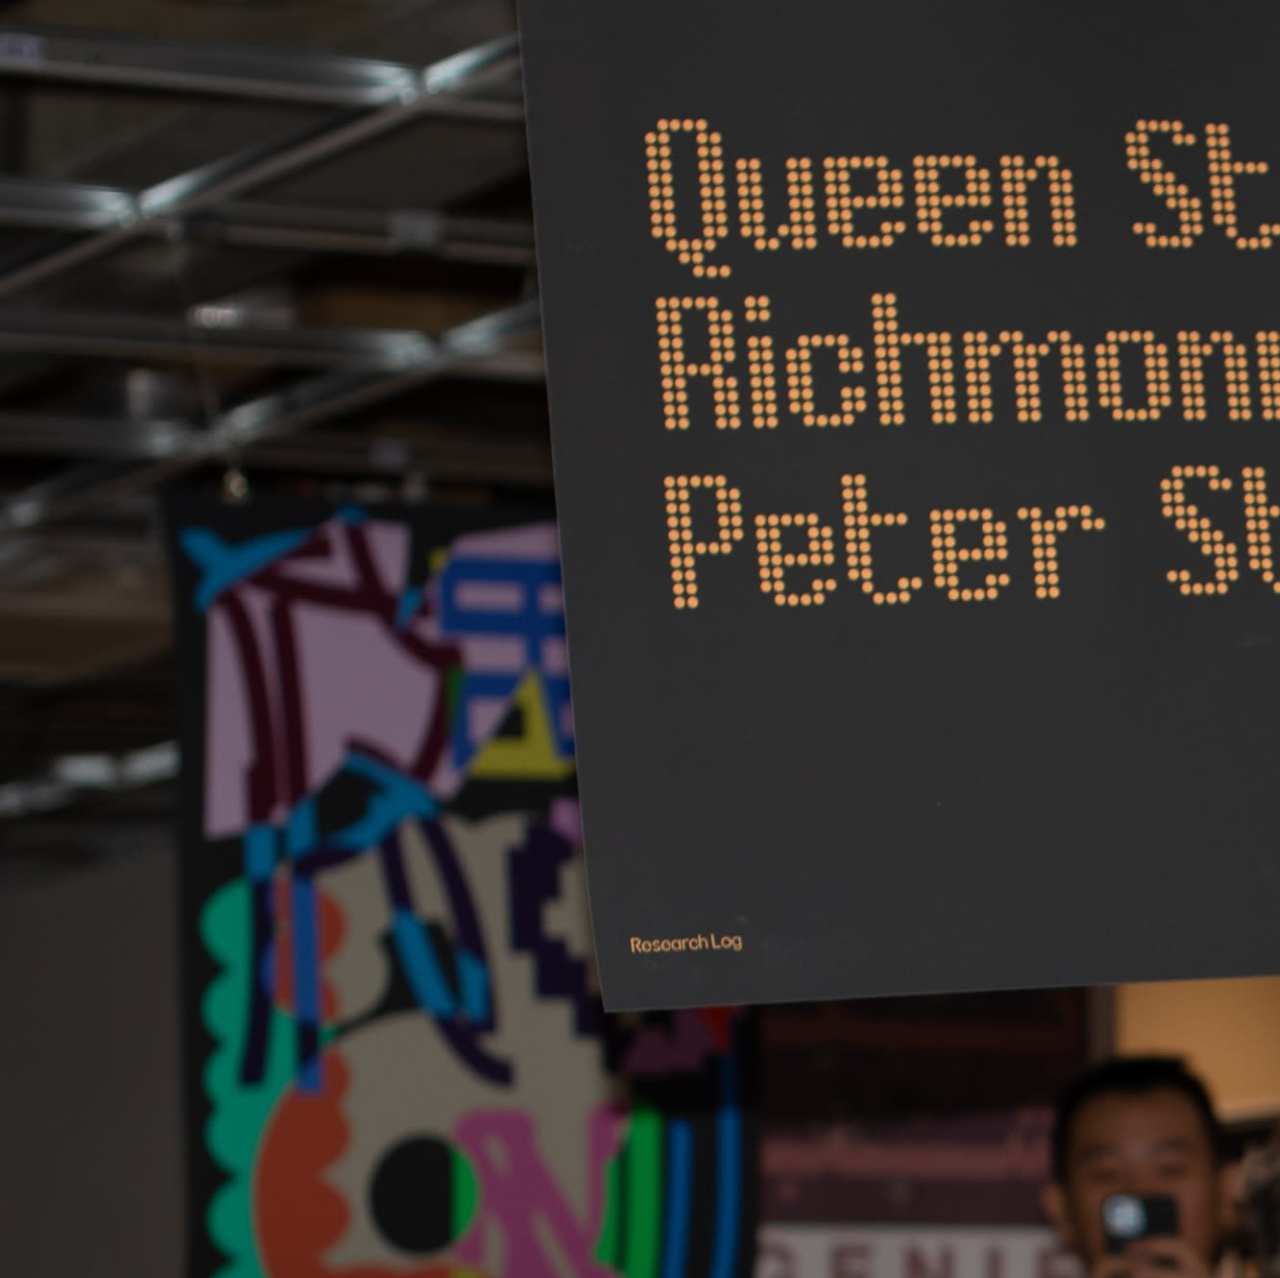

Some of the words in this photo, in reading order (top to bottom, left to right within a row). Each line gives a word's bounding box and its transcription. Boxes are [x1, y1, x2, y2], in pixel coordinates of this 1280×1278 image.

[644, 118, 1079, 278] Queen
[663, 473, 1106, 609] Peter
[629, 934, 709, 954] Research
[710, 933, 743, 953] Log
